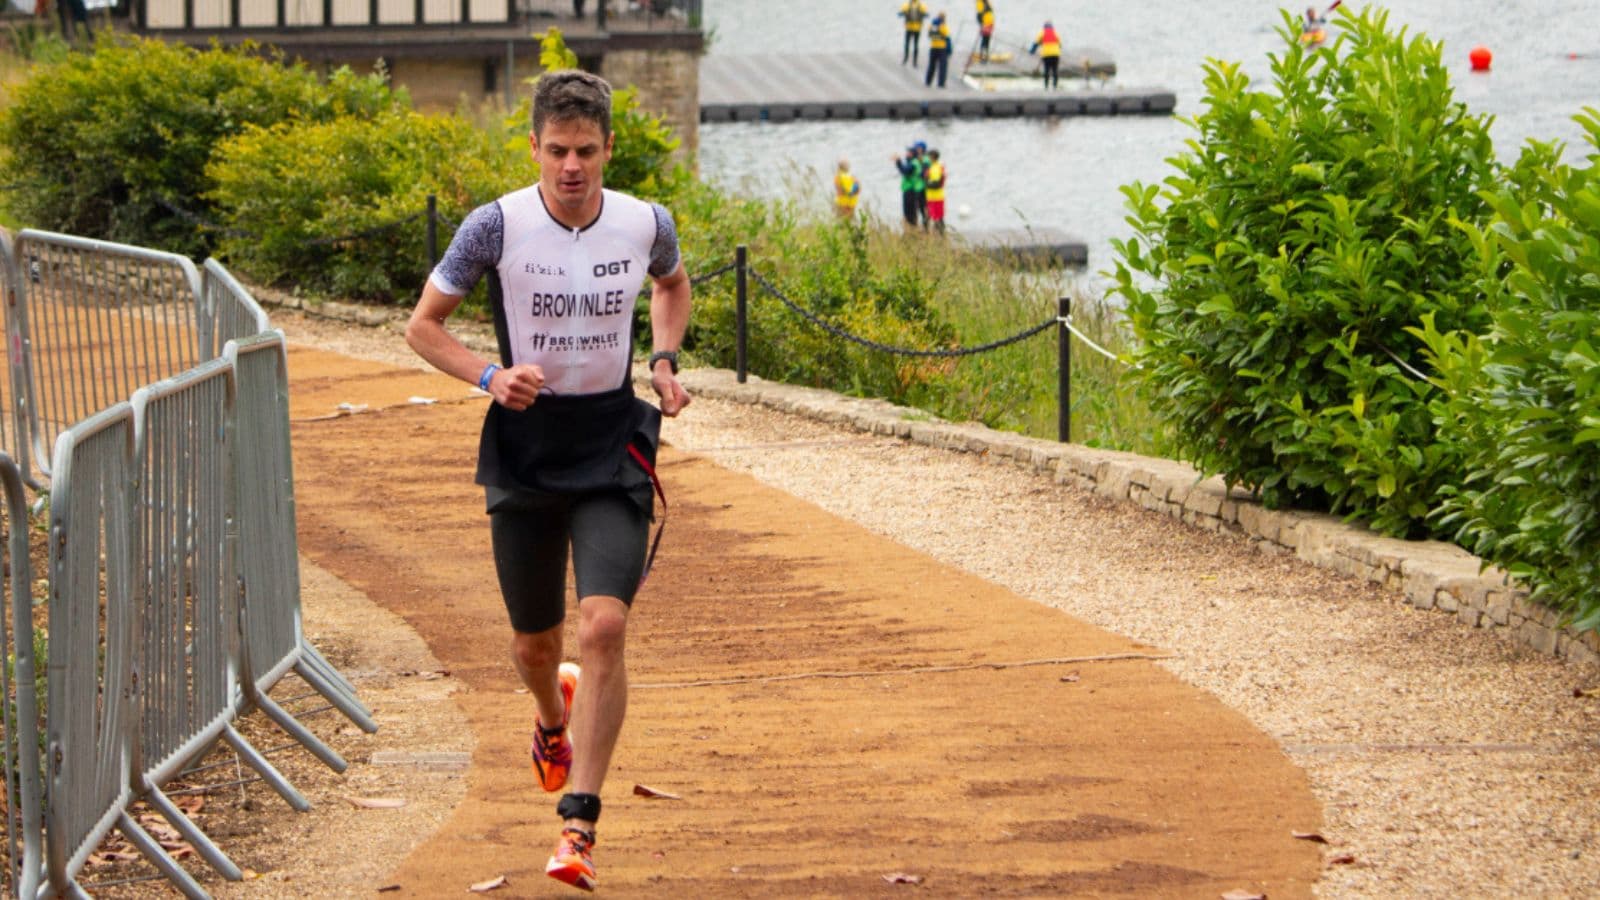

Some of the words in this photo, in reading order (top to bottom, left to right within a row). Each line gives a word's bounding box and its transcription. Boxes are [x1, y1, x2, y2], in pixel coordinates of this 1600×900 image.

[593, 260, 631, 277] OGT
[532, 290, 623, 318] BROWNLEE
[549, 332, 619, 346] BROWNLEE
